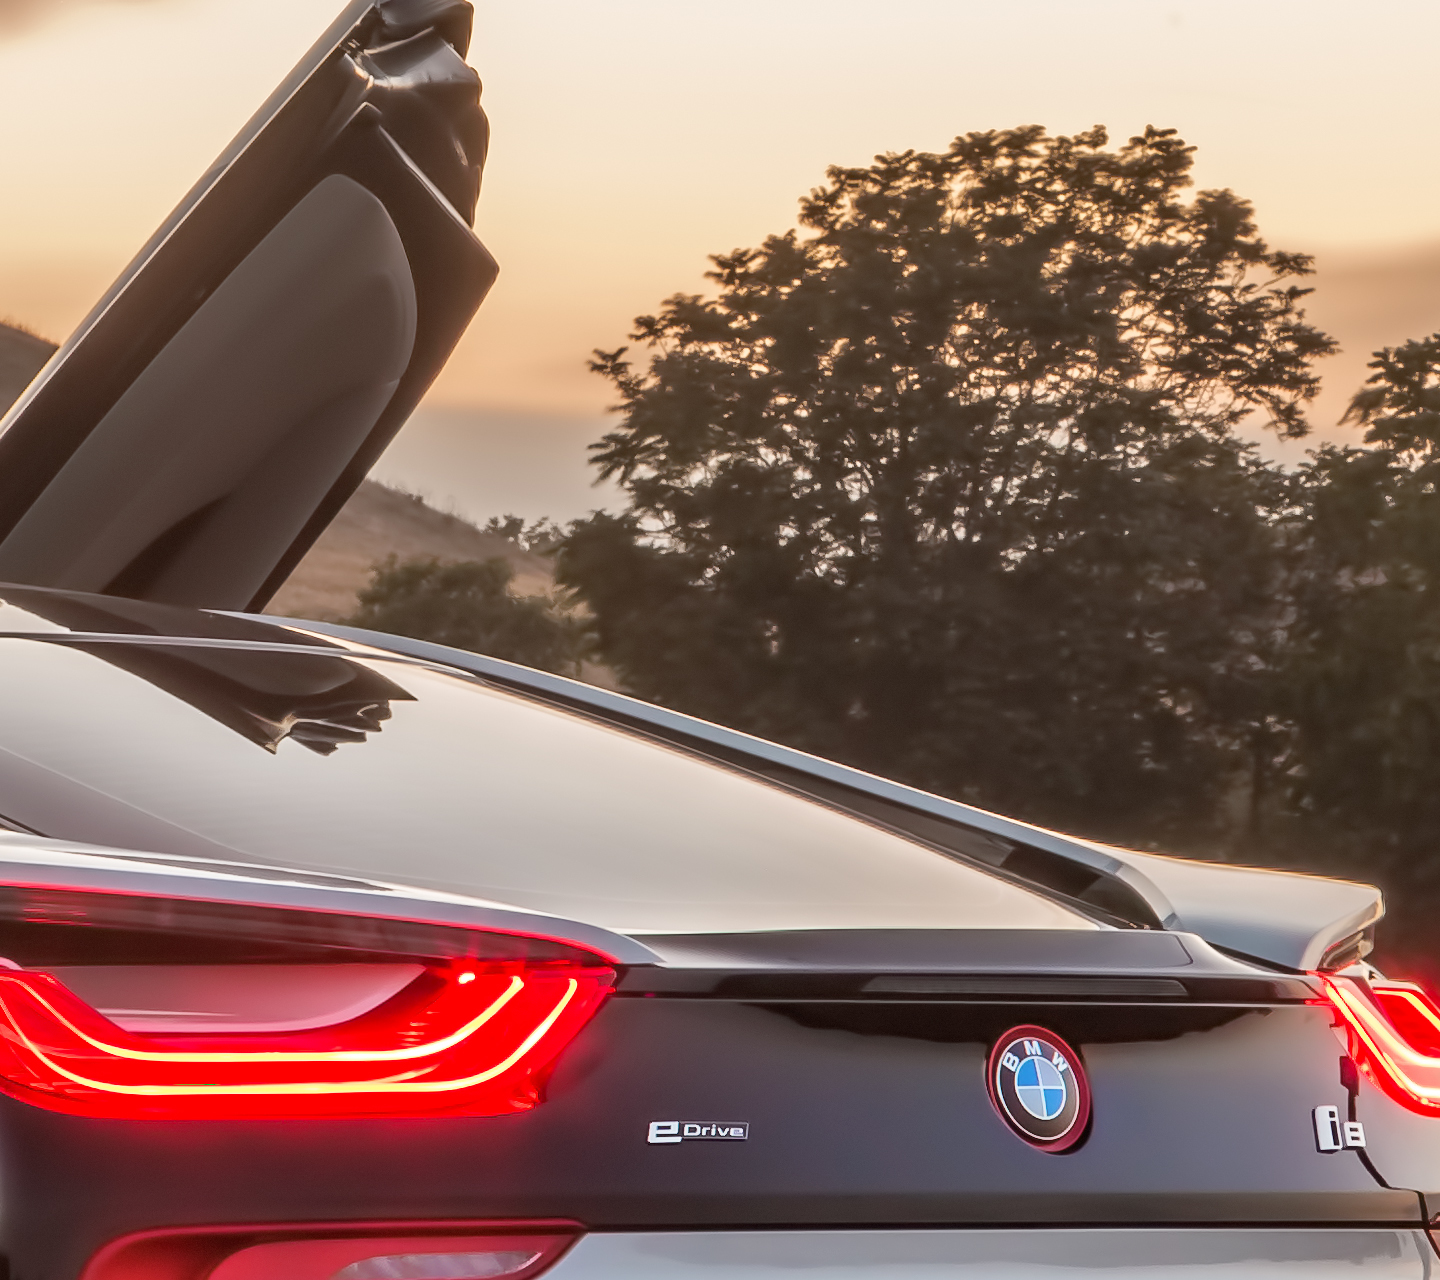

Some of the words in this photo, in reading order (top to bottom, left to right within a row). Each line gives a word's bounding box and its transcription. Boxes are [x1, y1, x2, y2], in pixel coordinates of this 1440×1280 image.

[1002, 1040, 1069, 1073] BMW
[647, 1120, 744, 1144] eDrive
[1315, 1105, 1366, 1151] i8
